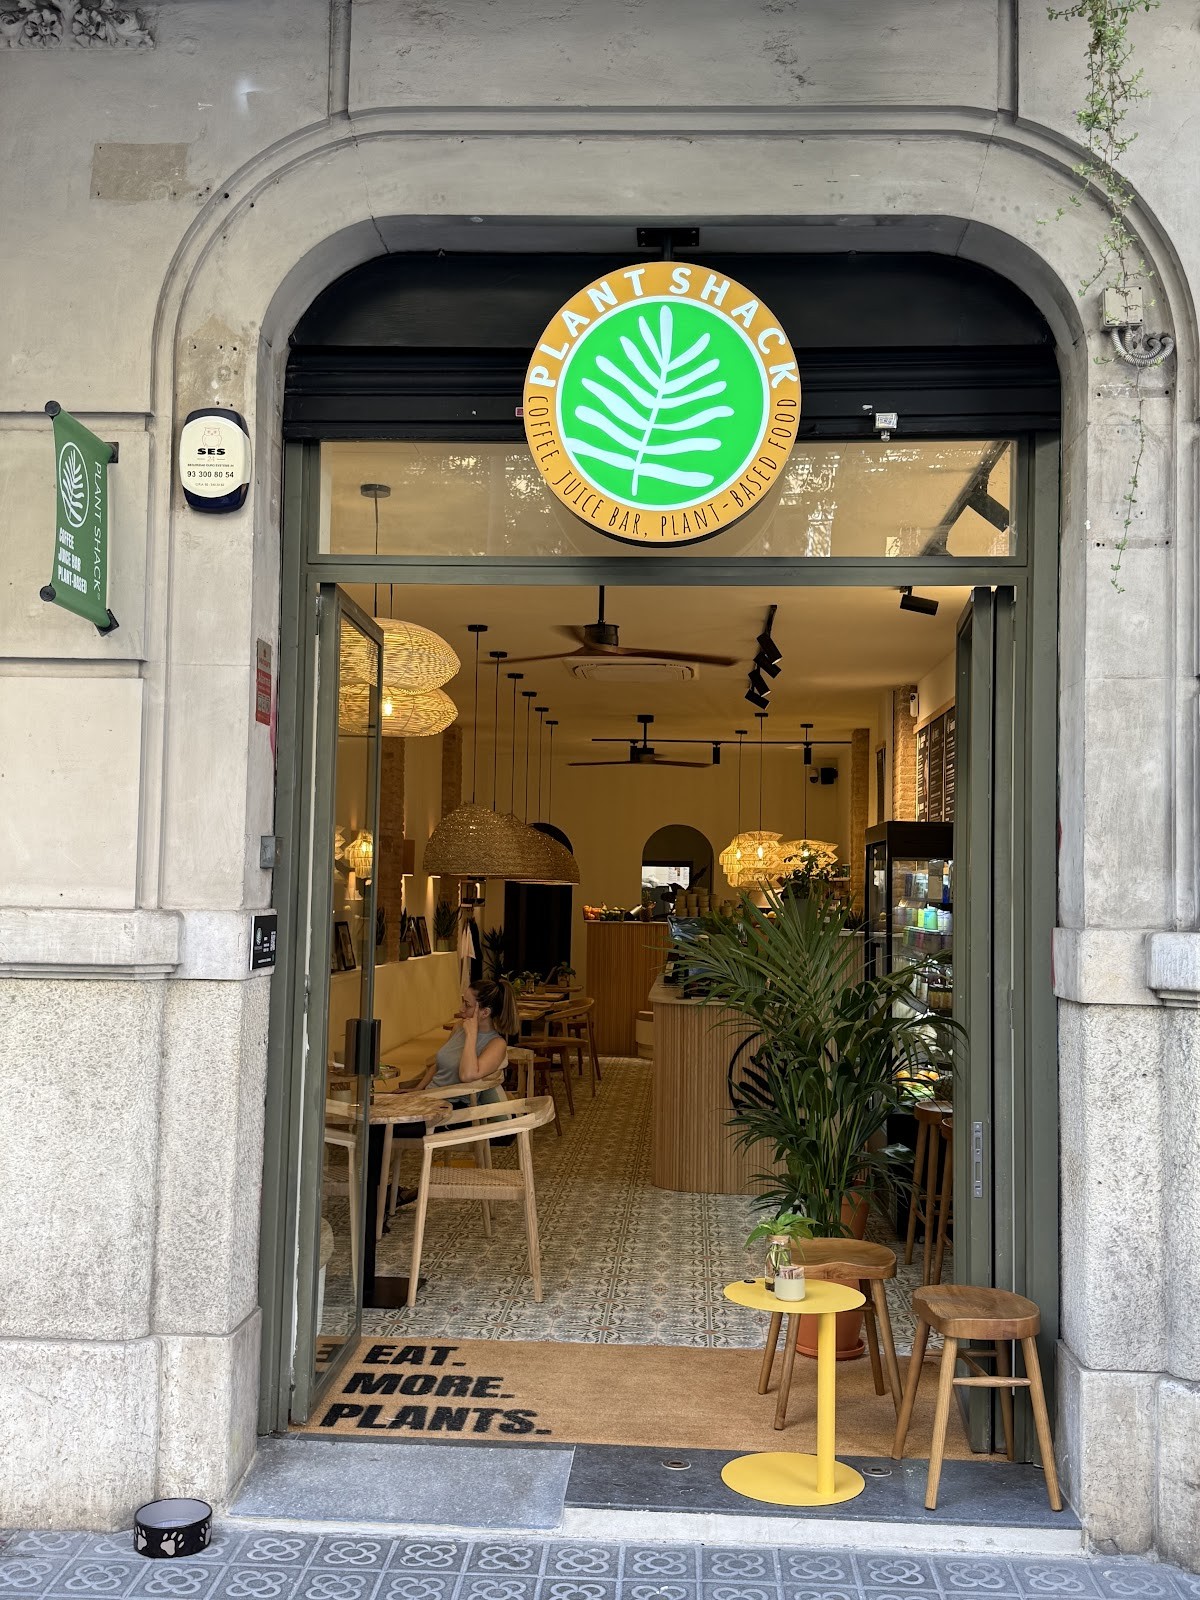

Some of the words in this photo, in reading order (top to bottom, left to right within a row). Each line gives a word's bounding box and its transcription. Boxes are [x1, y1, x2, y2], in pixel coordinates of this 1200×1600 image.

[529, 268, 646, 388] PLANT
[669, 267, 798, 389] SHACK
[197, 447, 226, 456] SES
[528, 395, 560, 472] COFFEE,
[552, 469, 605, 519] JUICE
[608, 506, 648, 538] BAR,
[661, 455, 778, 536] PLANT-BASED
[768, 398, 798, 451] FOOD
[187, 470, 196, 478] 93
[199, 470, 212, 478] 300
[94, 461, 102, 523] PLANT
[93, 525, 101, 592] SHACK
[362, 1344, 467, 1366] EAT.
[342, 1373, 516, 1399] MORE.
[319, 1403, 553, 1435] PLANTS.
